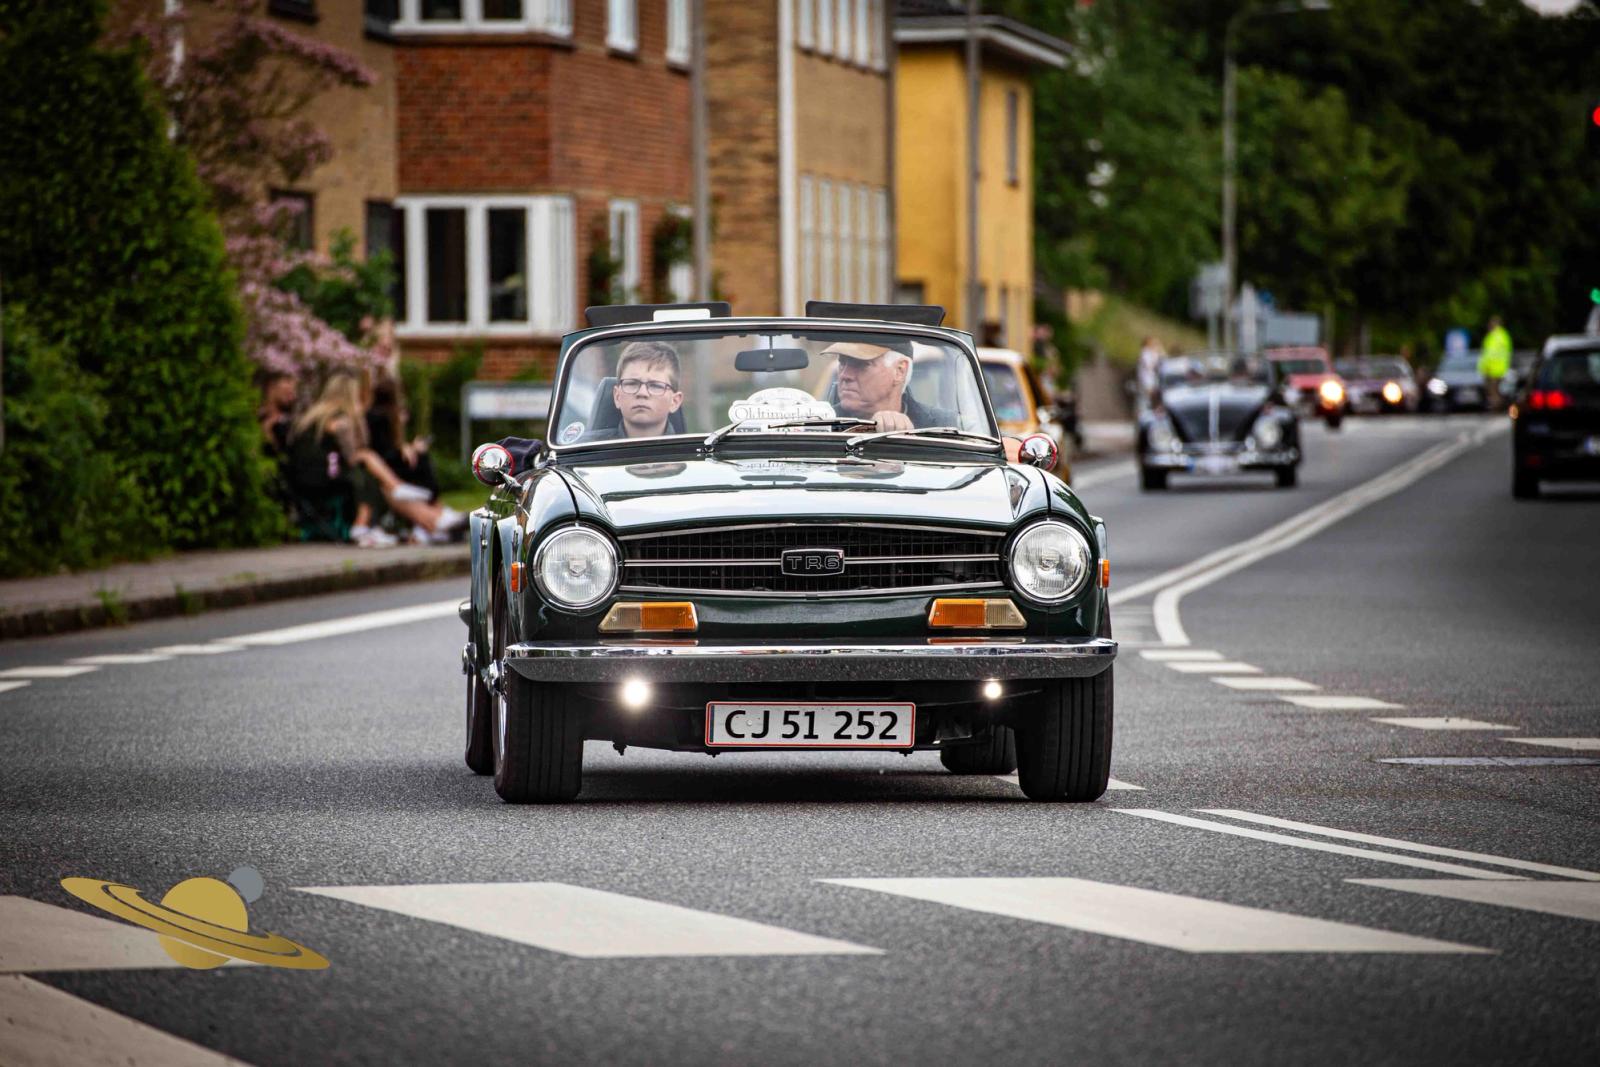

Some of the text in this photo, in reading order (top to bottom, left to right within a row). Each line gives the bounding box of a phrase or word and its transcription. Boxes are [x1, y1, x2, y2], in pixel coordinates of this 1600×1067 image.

[786, 555, 840, 570] TR6
[724, 709, 898, 740] CJ 51 252
